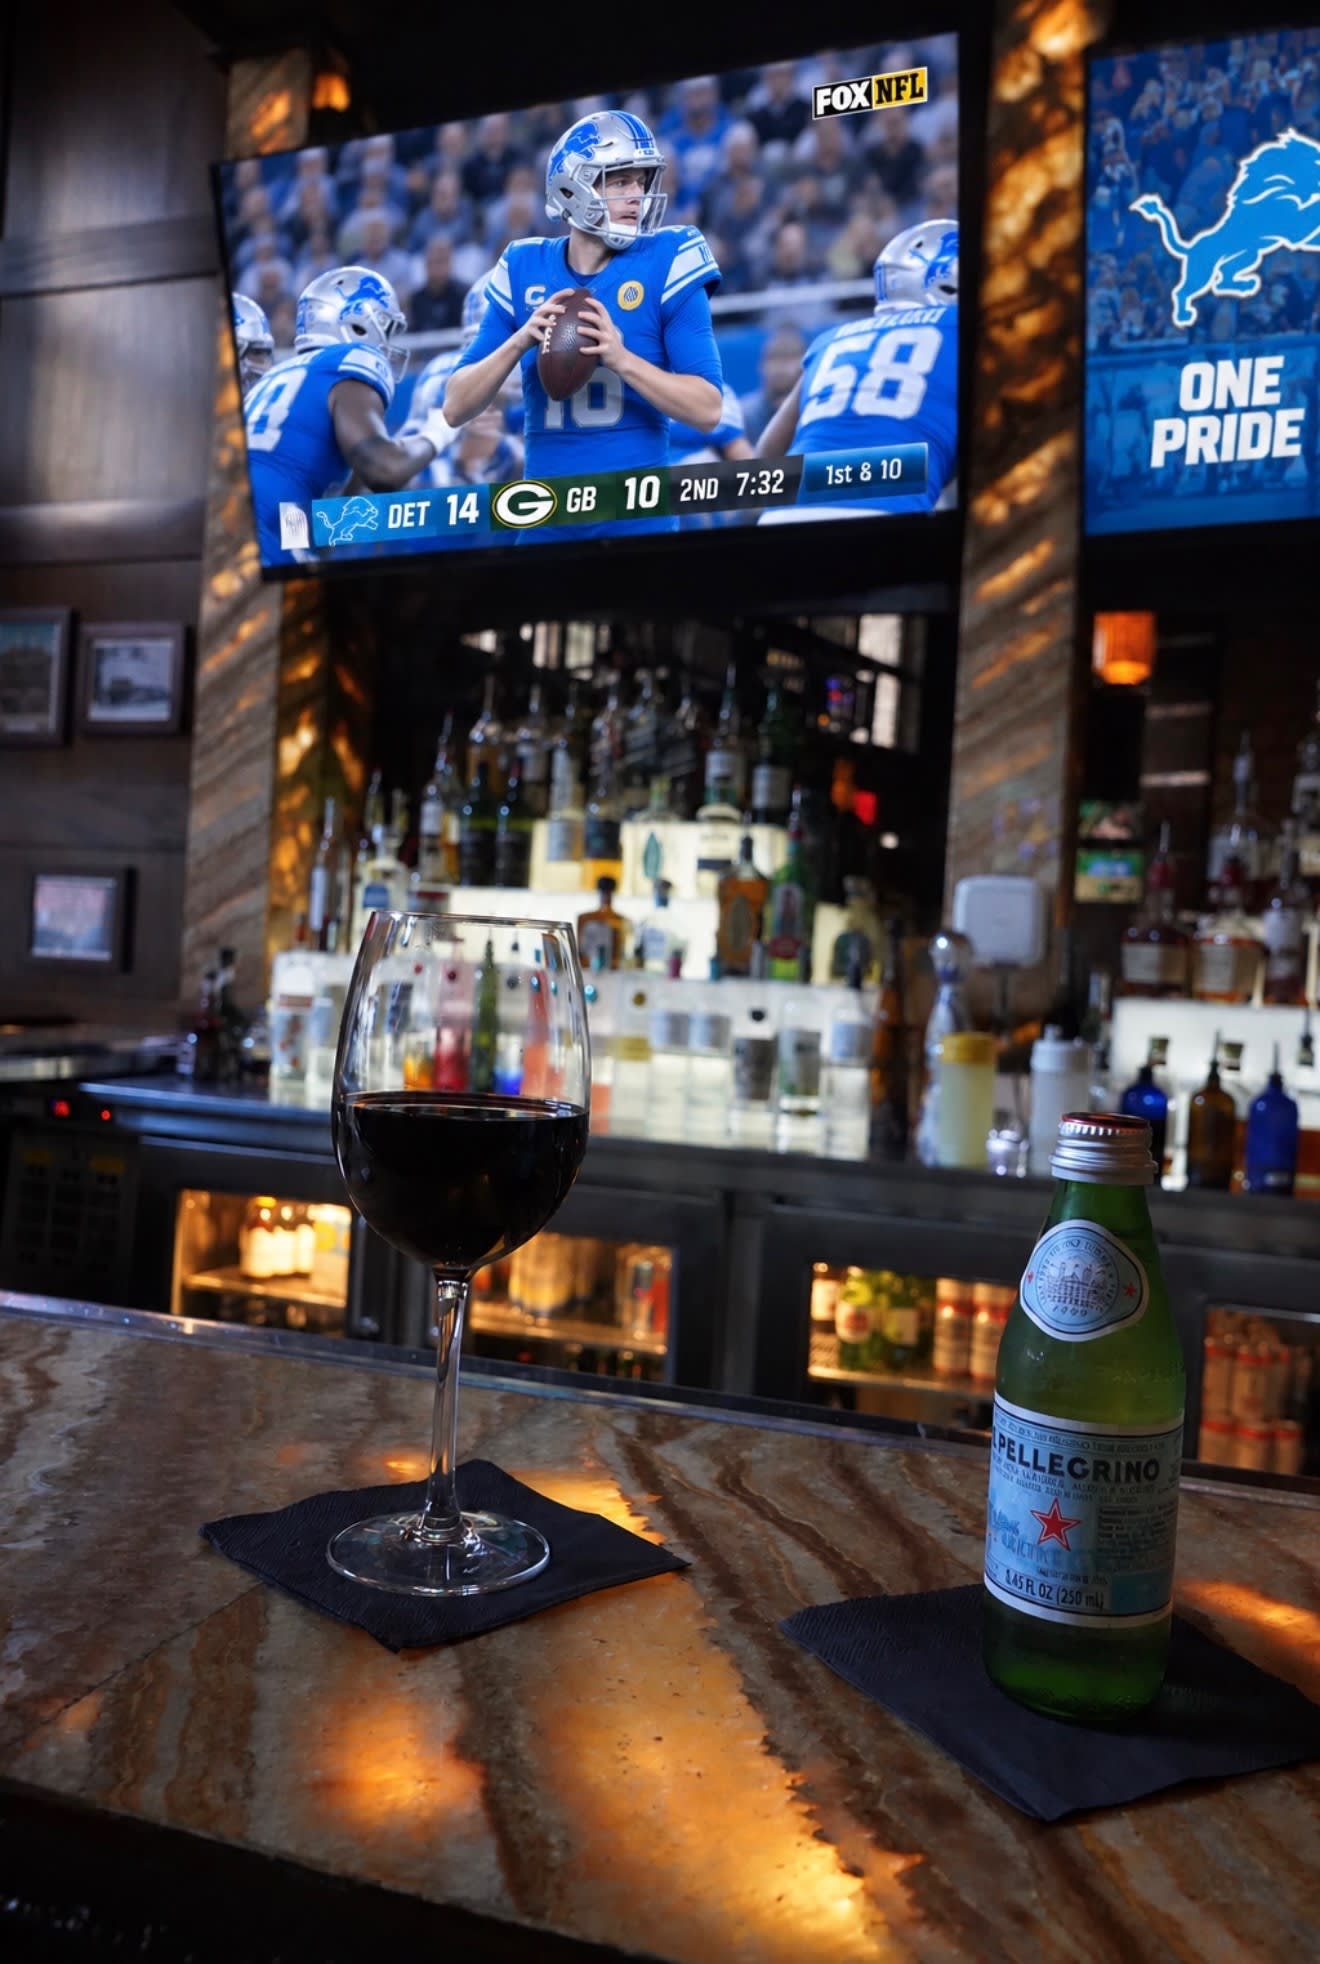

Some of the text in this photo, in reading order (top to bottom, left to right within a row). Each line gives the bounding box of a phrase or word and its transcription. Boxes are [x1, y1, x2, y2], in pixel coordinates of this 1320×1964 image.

[816, 73, 924, 116] FOX NFL
[801, 325, 943, 426] 58
[1179, 355, 1285, 412] ONE
[1150, 408, 1306, 468] PRIDE
[679, 469, 785, 502] 2ND 7:32
[826, 464, 853, 485] 1st
[880, 457, 902, 480] 10
[387, 492, 480, 529] DET 14
[566, 475, 661, 513] GB 10
